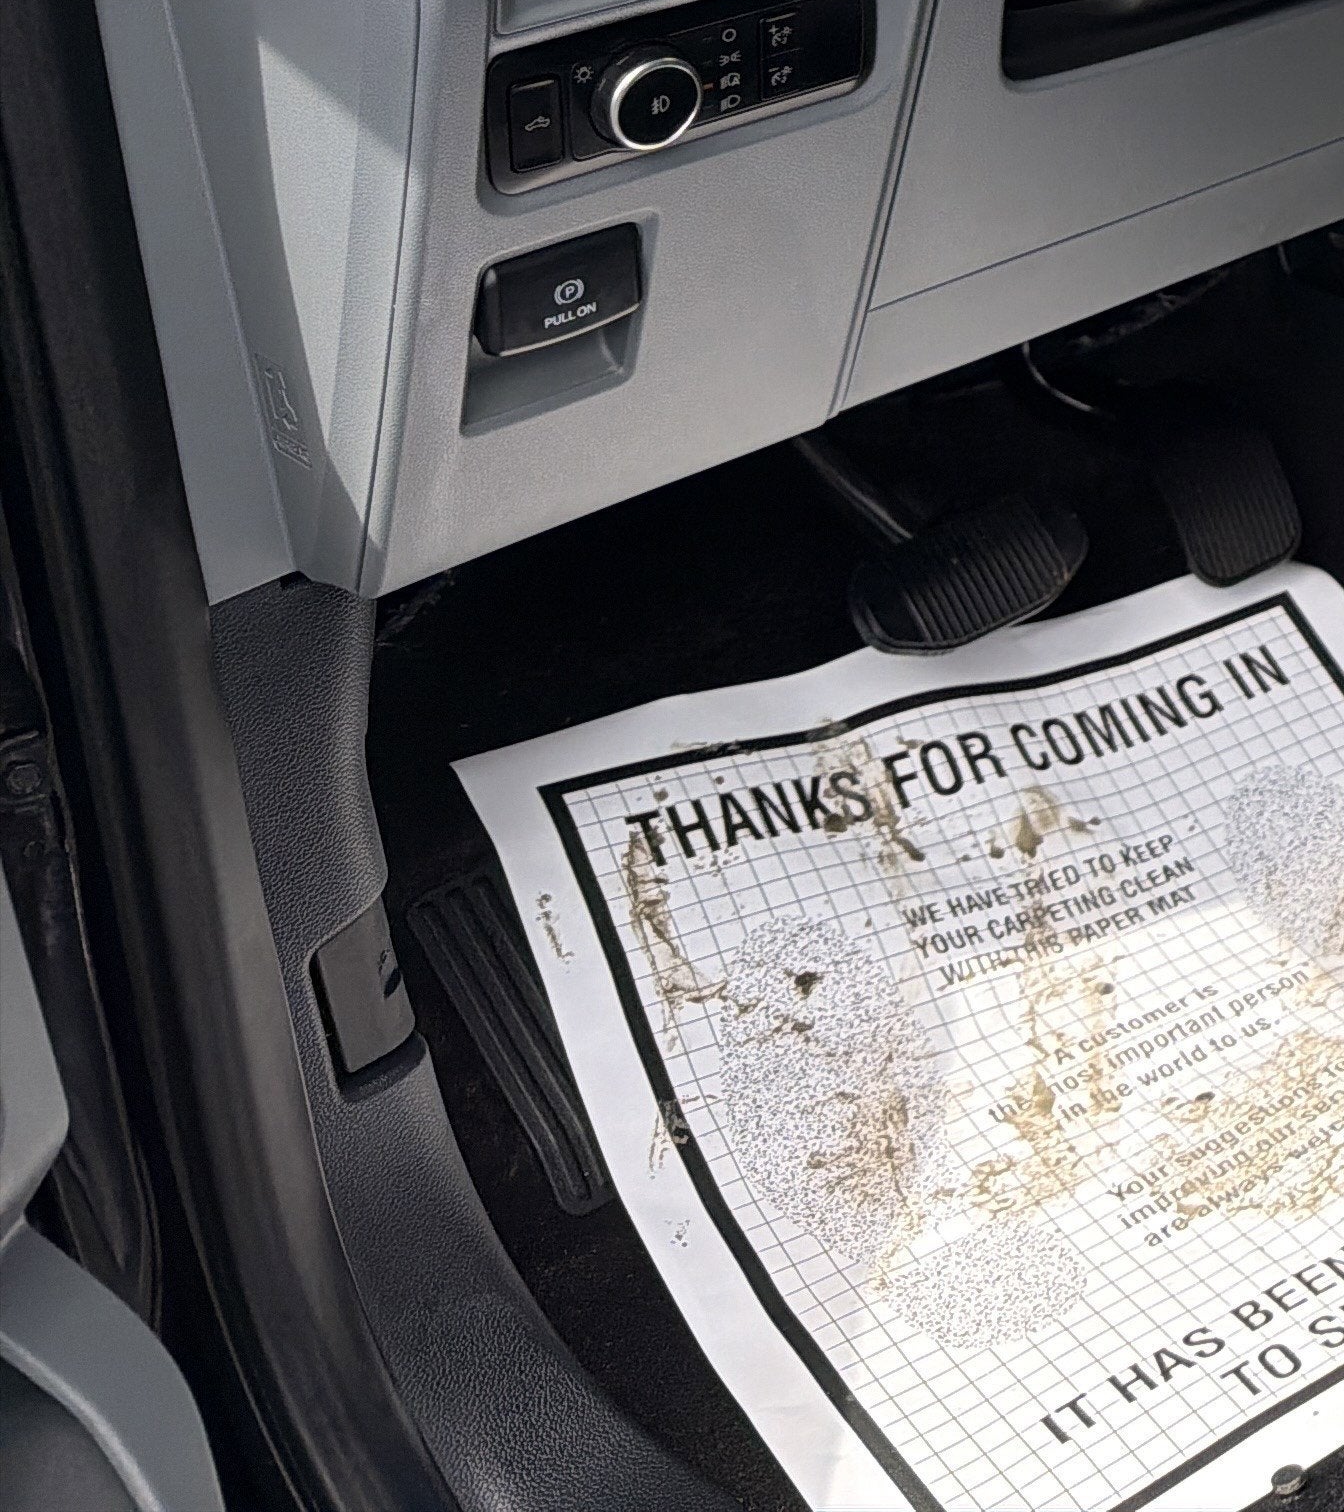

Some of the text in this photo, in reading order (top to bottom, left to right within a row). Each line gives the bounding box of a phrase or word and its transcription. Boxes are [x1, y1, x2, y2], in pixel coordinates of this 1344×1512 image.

[544, 301, 597, 329] PULL ON
[625, 644, 1291, 867] THANKS FOR COMING IN
[902, 834, 1173, 928] WE HAVE TRIED TO KEEP
[913, 856, 1195, 959] YOUR CARPETING CLEAN
[938, 950, 1004, 986] WITH
[1067, 907, 1145, 947] PAPER
[1146, 886, 1198, 917] MAT
[988, 1097, 1033, 1124] the
[1107, 1005, 1225, 1070] important
[1228, 969, 1311, 1018] person
[1054, 983, 1221, 1066] A customer is
[1059, 1015, 1282, 1123] in the world to us.
[1105, 1164, 1174, 1202] Your
[1175, 1077, 1323, 1169] suggestions
[1117, 1147, 1250, 1230] improving
[1254, 1119, 1298, 1151] our
[1143, 1214, 1191, 1248] are
[1197, 1164, 1284, 1219] always
[1039, 1392, 1098, 1445] IT
[1105, 1326, 1227, 1405] HAS
[1220, 1342, 1302, 1398] TO
